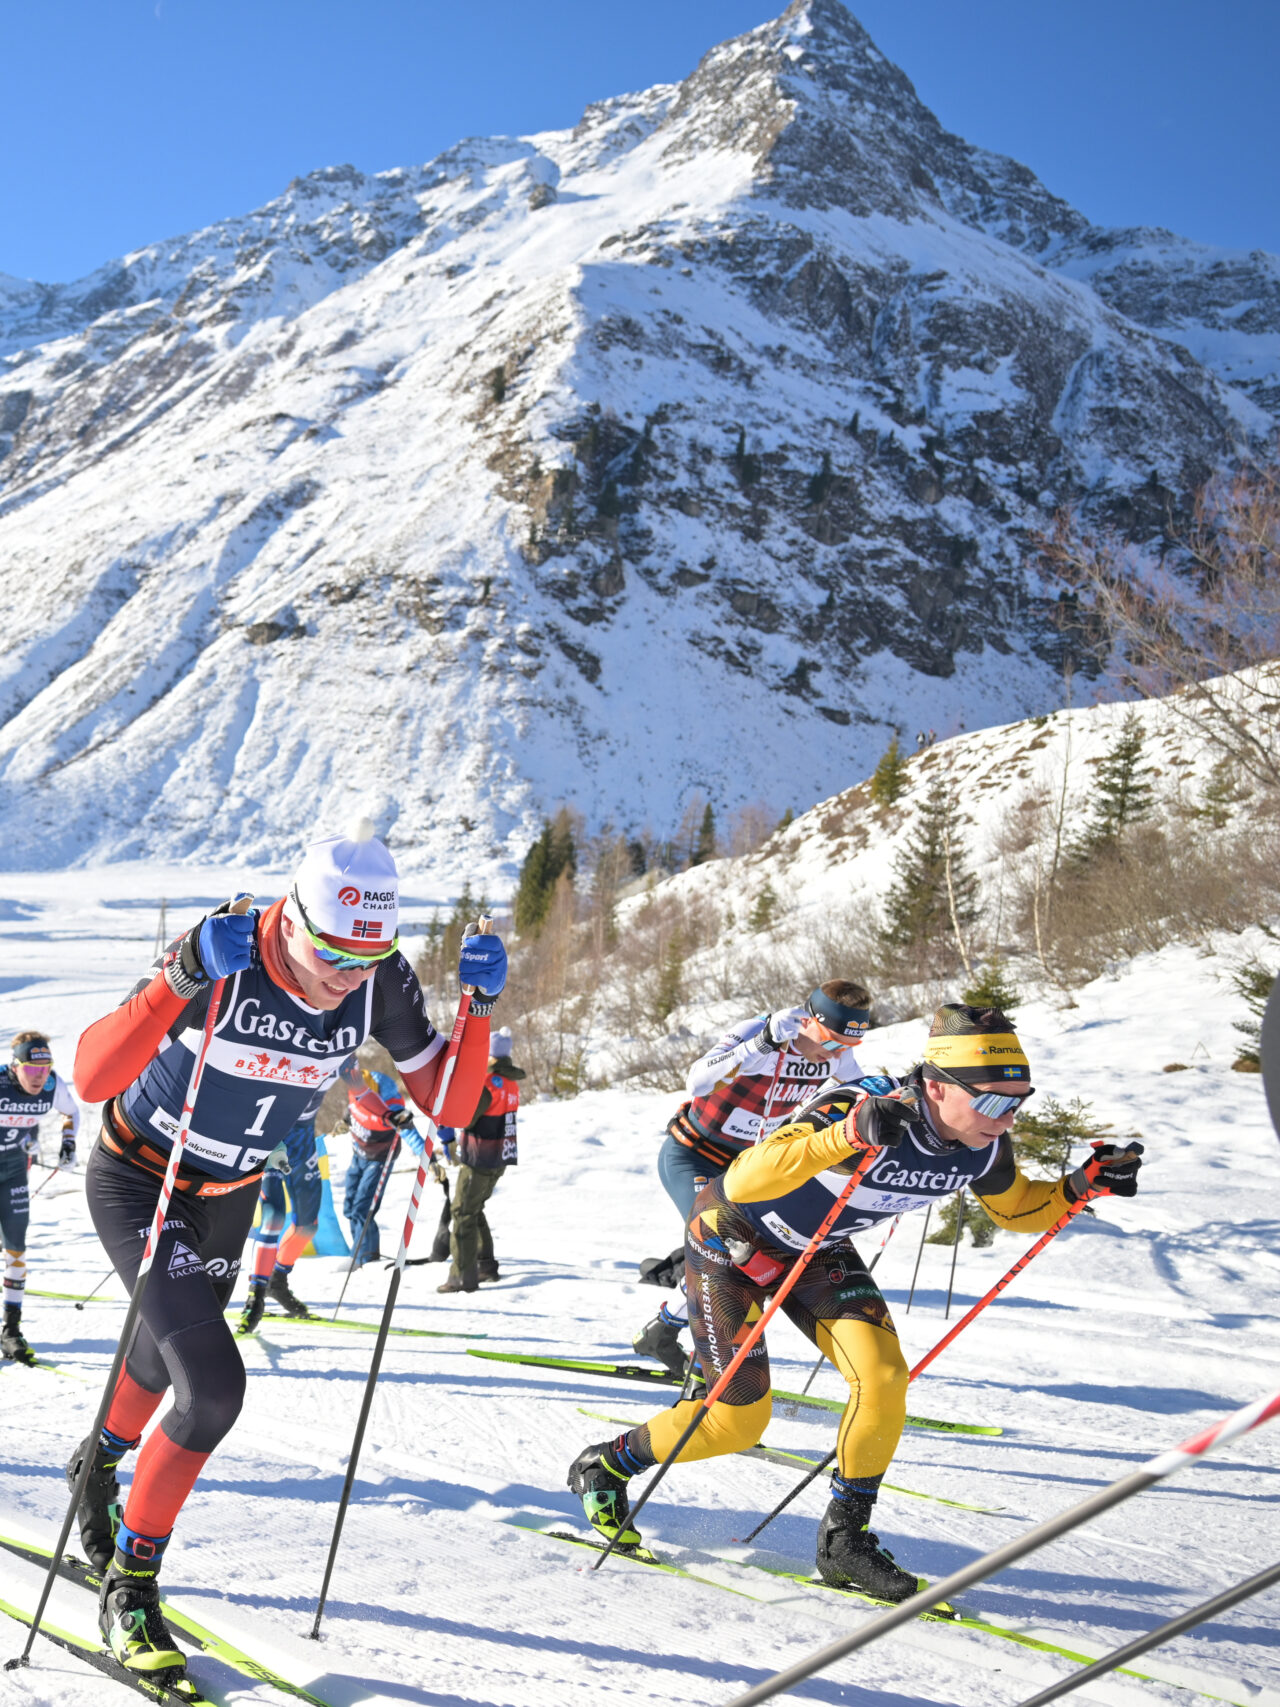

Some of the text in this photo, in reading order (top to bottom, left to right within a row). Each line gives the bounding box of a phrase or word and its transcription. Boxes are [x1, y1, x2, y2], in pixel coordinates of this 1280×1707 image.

[234, 998, 357, 1054] Gastein
[244, 1095, 276, 1136] 1
[4, 1129, 19, 1142] 9
[188, 1142, 227, 1159] alpresor
[871, 1160, 974, 1190] Gastein
[701, 1272, 723, 1375] SWEDEMOUNT
[138, 1678, 170, 1702] FISCHER
